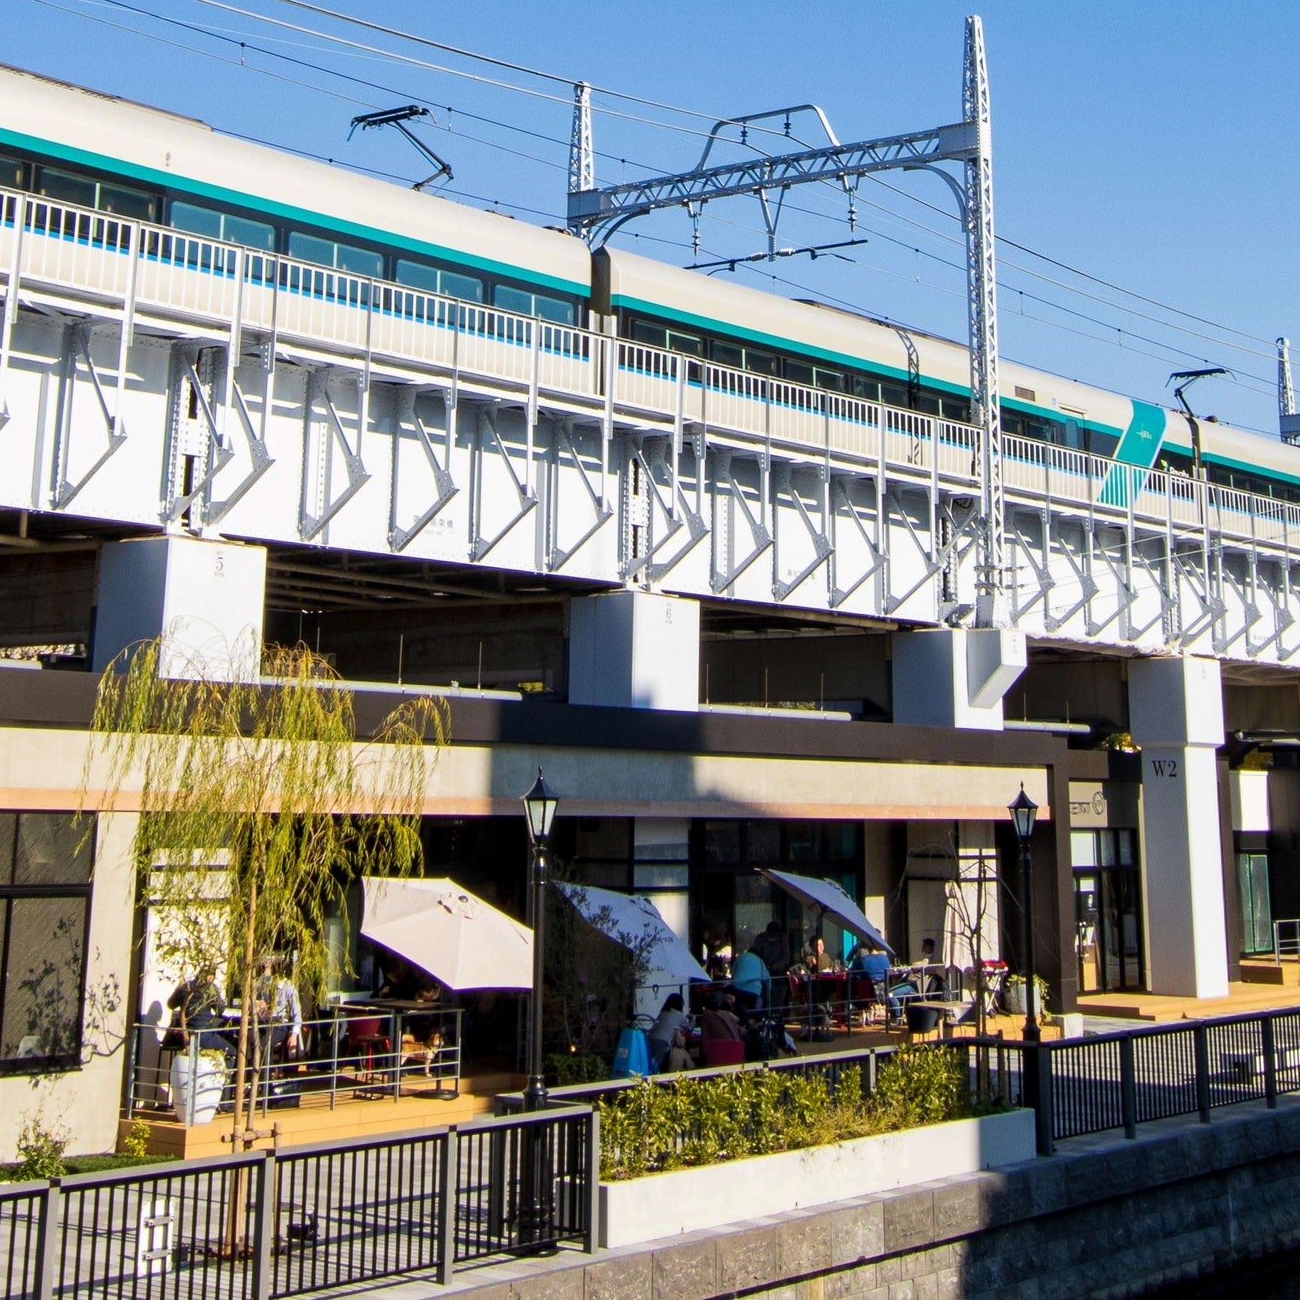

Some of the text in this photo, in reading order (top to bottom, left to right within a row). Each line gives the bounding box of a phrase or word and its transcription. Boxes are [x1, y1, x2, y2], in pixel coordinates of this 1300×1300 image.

[216, 557, 224, 571] 5
[666, 607, 672, 619] 6
[1152, 760, 1178, 778] W2
